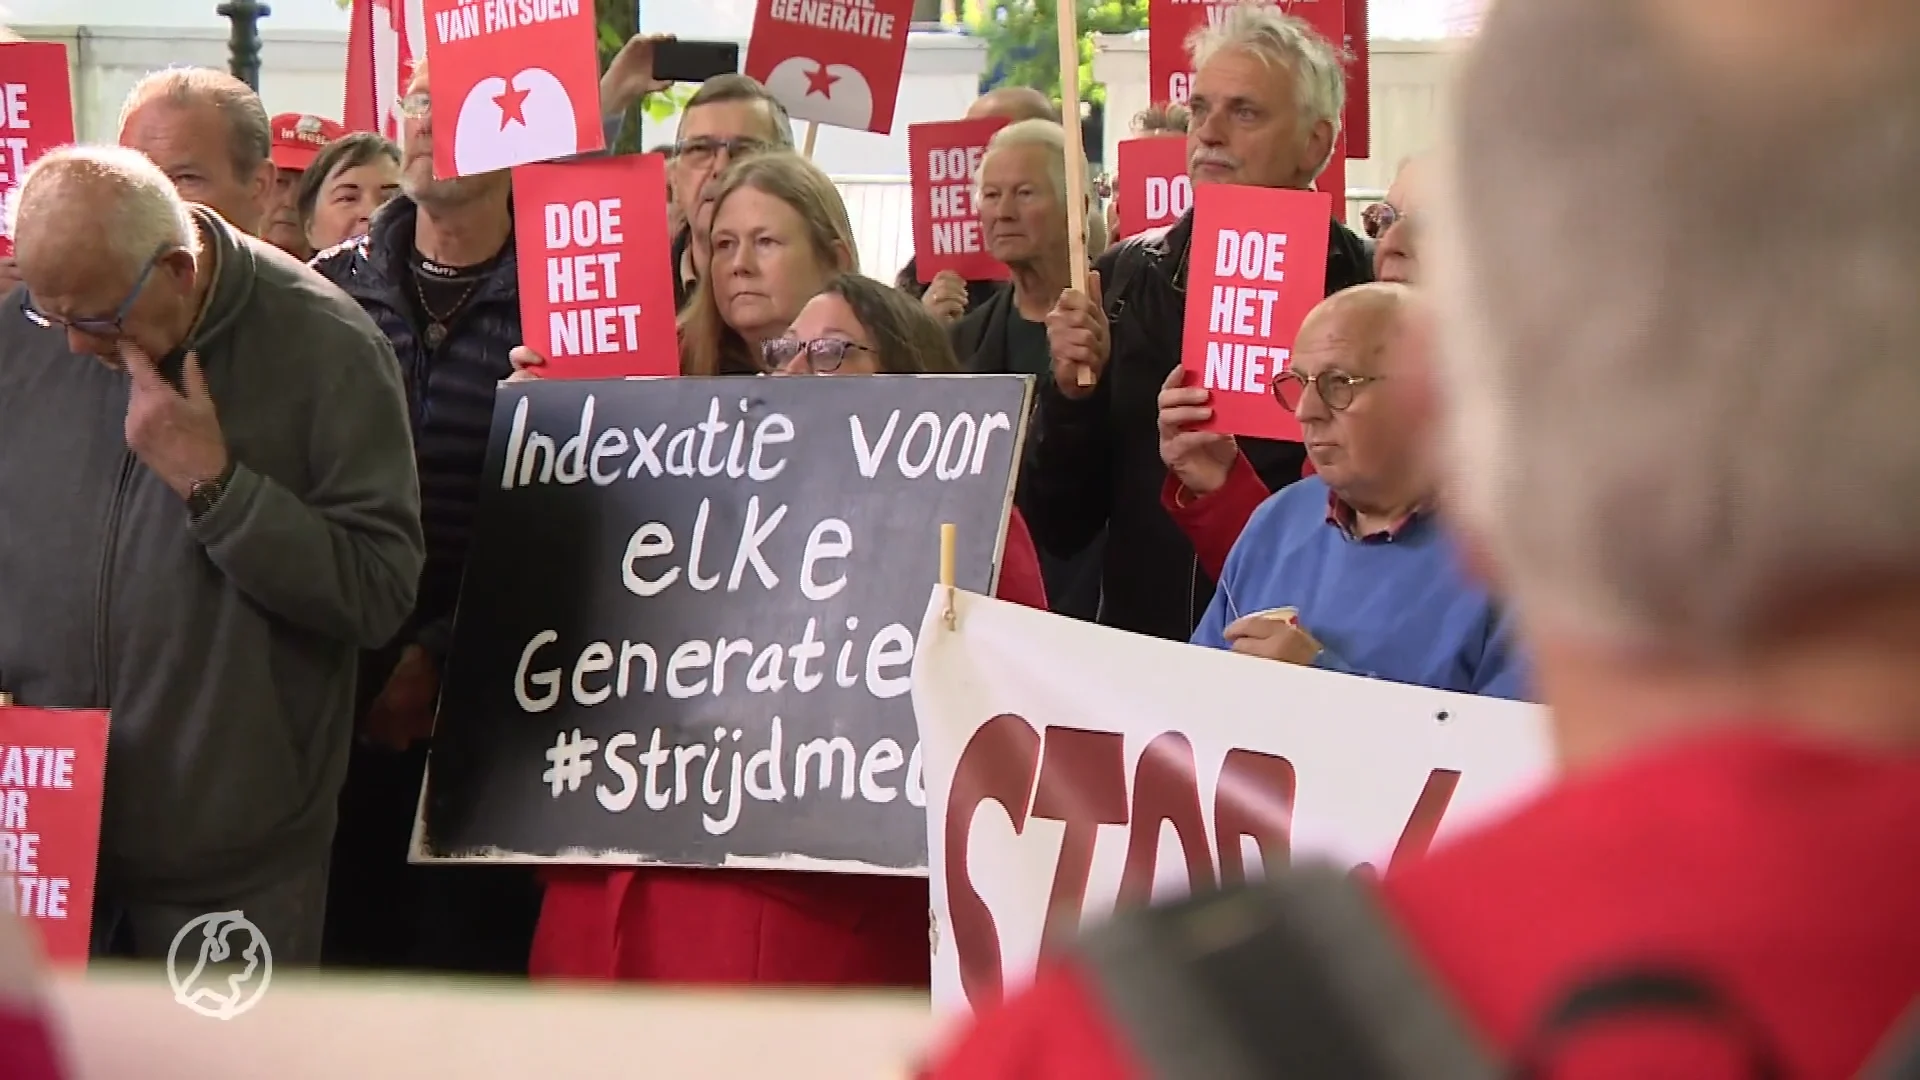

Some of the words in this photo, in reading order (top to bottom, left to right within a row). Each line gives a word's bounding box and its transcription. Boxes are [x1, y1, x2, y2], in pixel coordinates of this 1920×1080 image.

[434, 4, 481, 45] VAN
[771, 0, 895, 39] GENERATIE
[545, 198, 624, 249] DOE
[1146, 175, 1194, 220] DO
[931, 221, 984, 255] NIE
[1214, 229, 1288, 282] DOE
[547, 252, 621, 304] HET
[550, 305, 642, 357] NIET
[1208, 285, 1279, 338] HET
[1203, 341, 1290, 394] NIET
[502, 394, 795, 489] Indexatie
[849, 409, 1012, 481] voor
[514, 616, 914, 713] Generatie
[0, 746, 76, 789] ATIE
